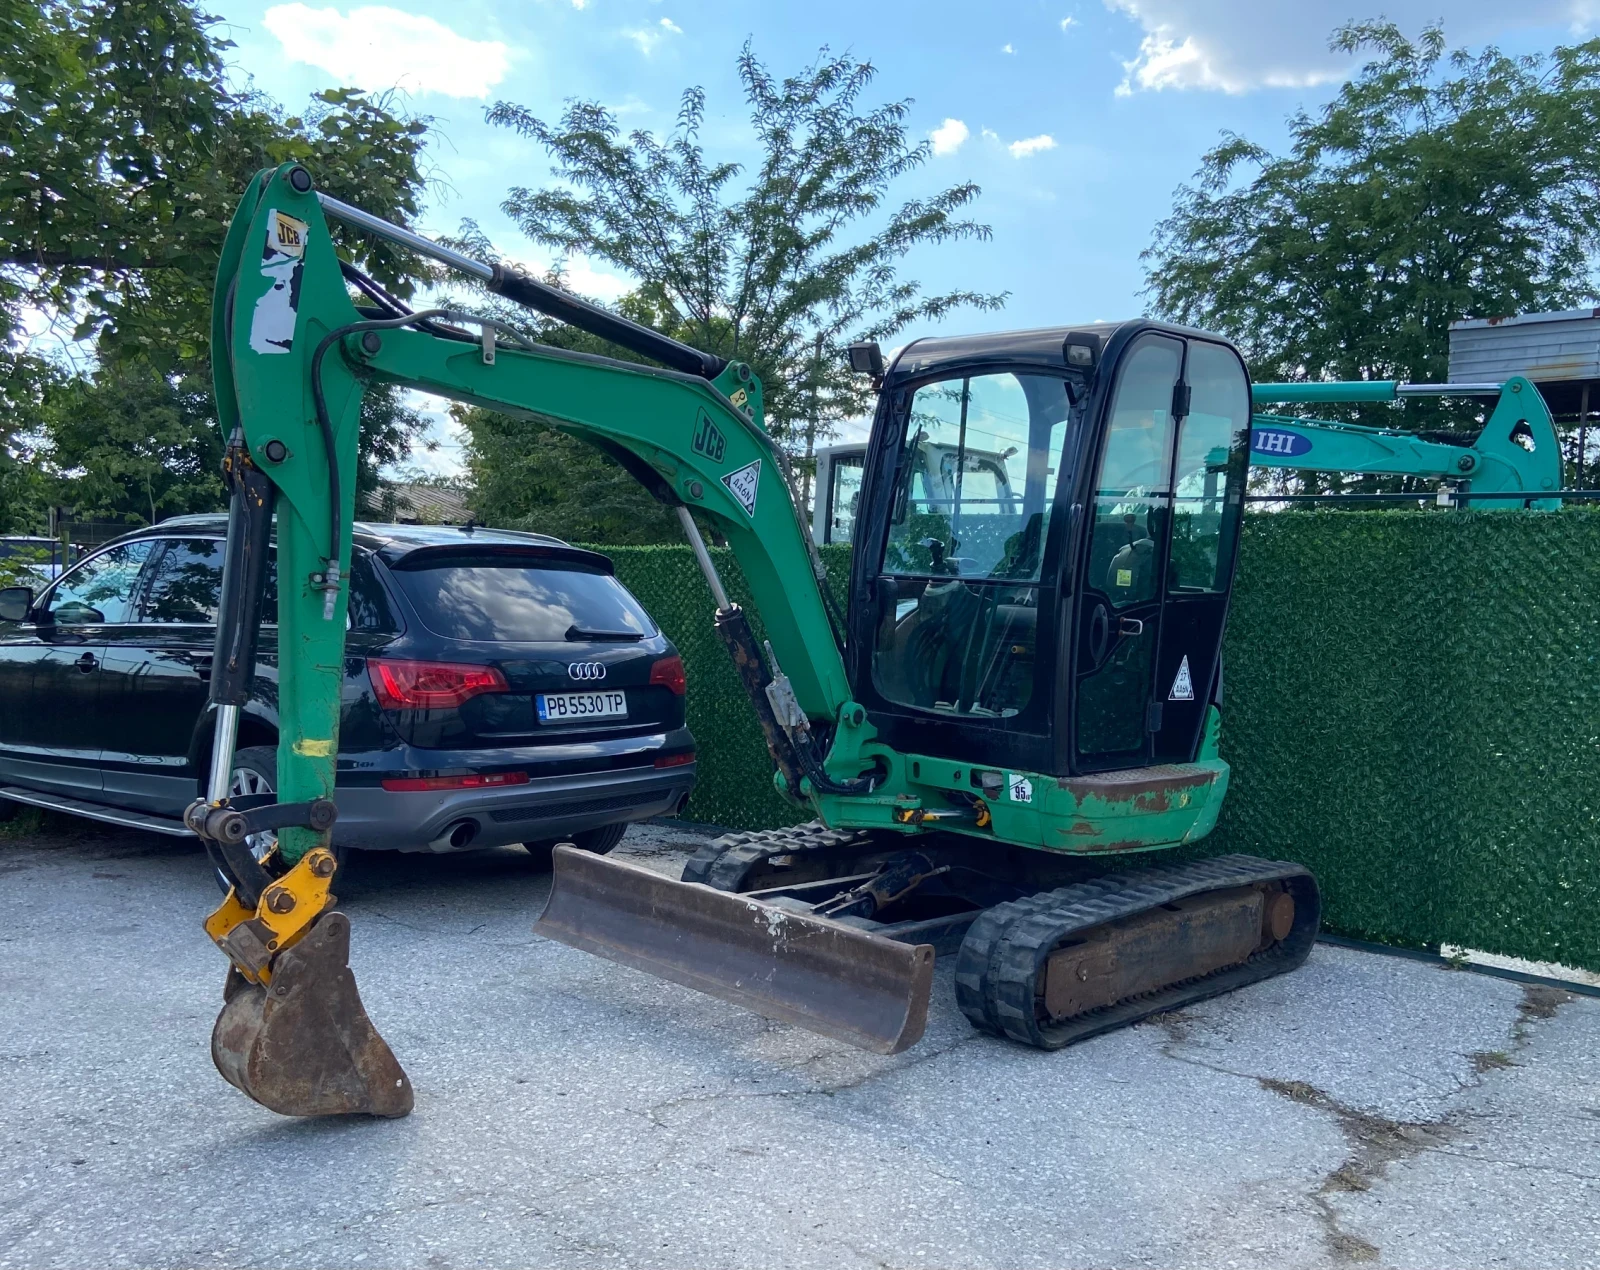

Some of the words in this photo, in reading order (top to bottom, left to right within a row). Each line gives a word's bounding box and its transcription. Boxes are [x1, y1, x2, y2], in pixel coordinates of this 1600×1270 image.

[277, 222, 300, 245] JCB
[694, 415, 725, 461] JCB
[1255, 431, 1296, 454] IHI
[732, 478, 752, 502] AA6N
[743, 472, 755, 485] 17
[547, 697, 568, 716] PB
[568, 695, 604, 715] 5530
[605, 693, 624, 713] TP
[1015, 785, 1026, 800] 95
